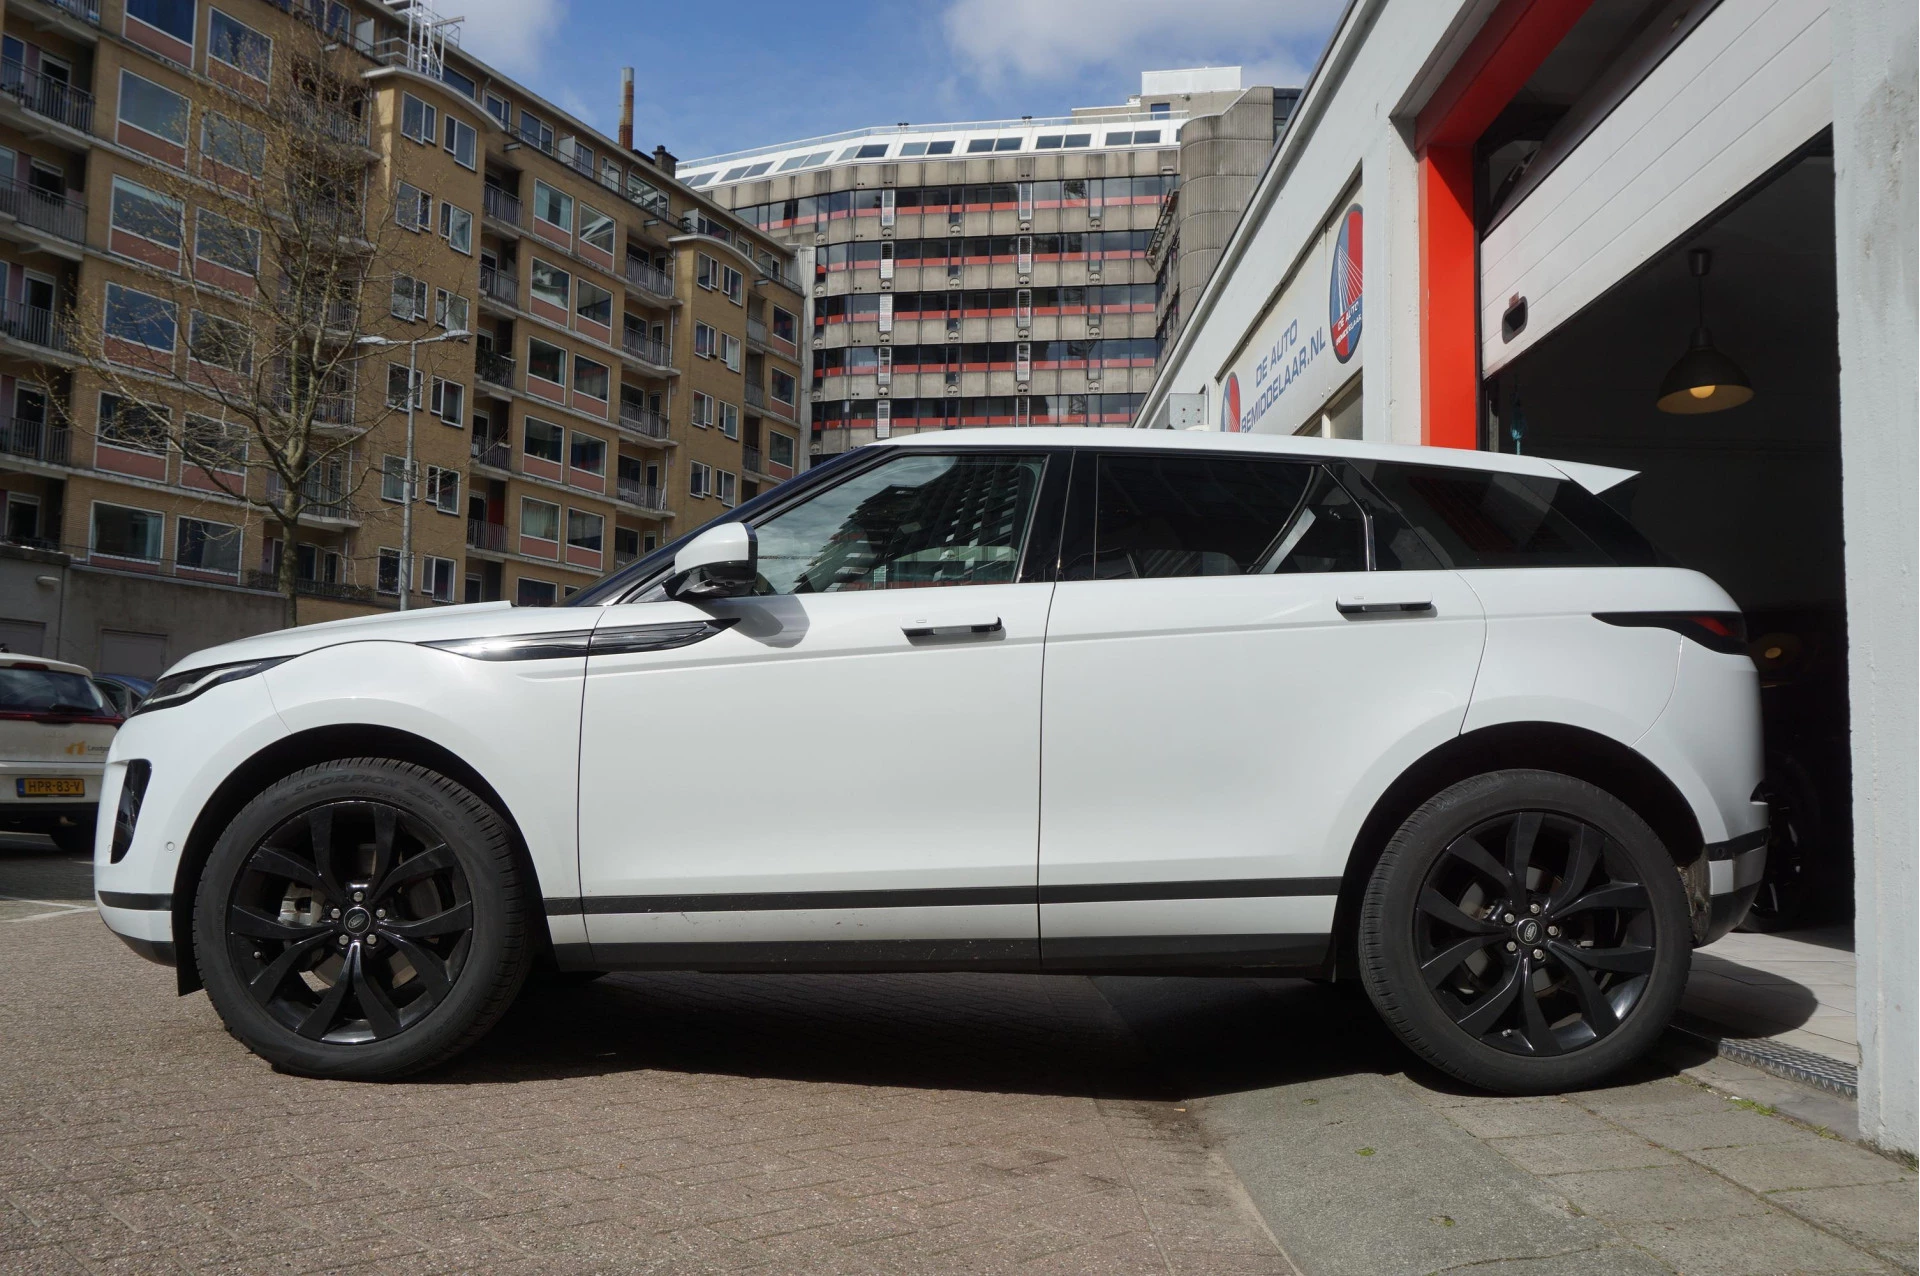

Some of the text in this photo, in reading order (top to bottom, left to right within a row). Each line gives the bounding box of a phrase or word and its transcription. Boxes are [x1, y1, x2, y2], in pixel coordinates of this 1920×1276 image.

[1241, 326, 1326, 433] BEMIDDELAAR.NL
[1256, 318, 1298, 388] DE AUTO
[28, 781, 80, 793] HPR-83-V
[293, 773, 400, 796] SCORPION
[405, 786, 455, 821] ZERO
